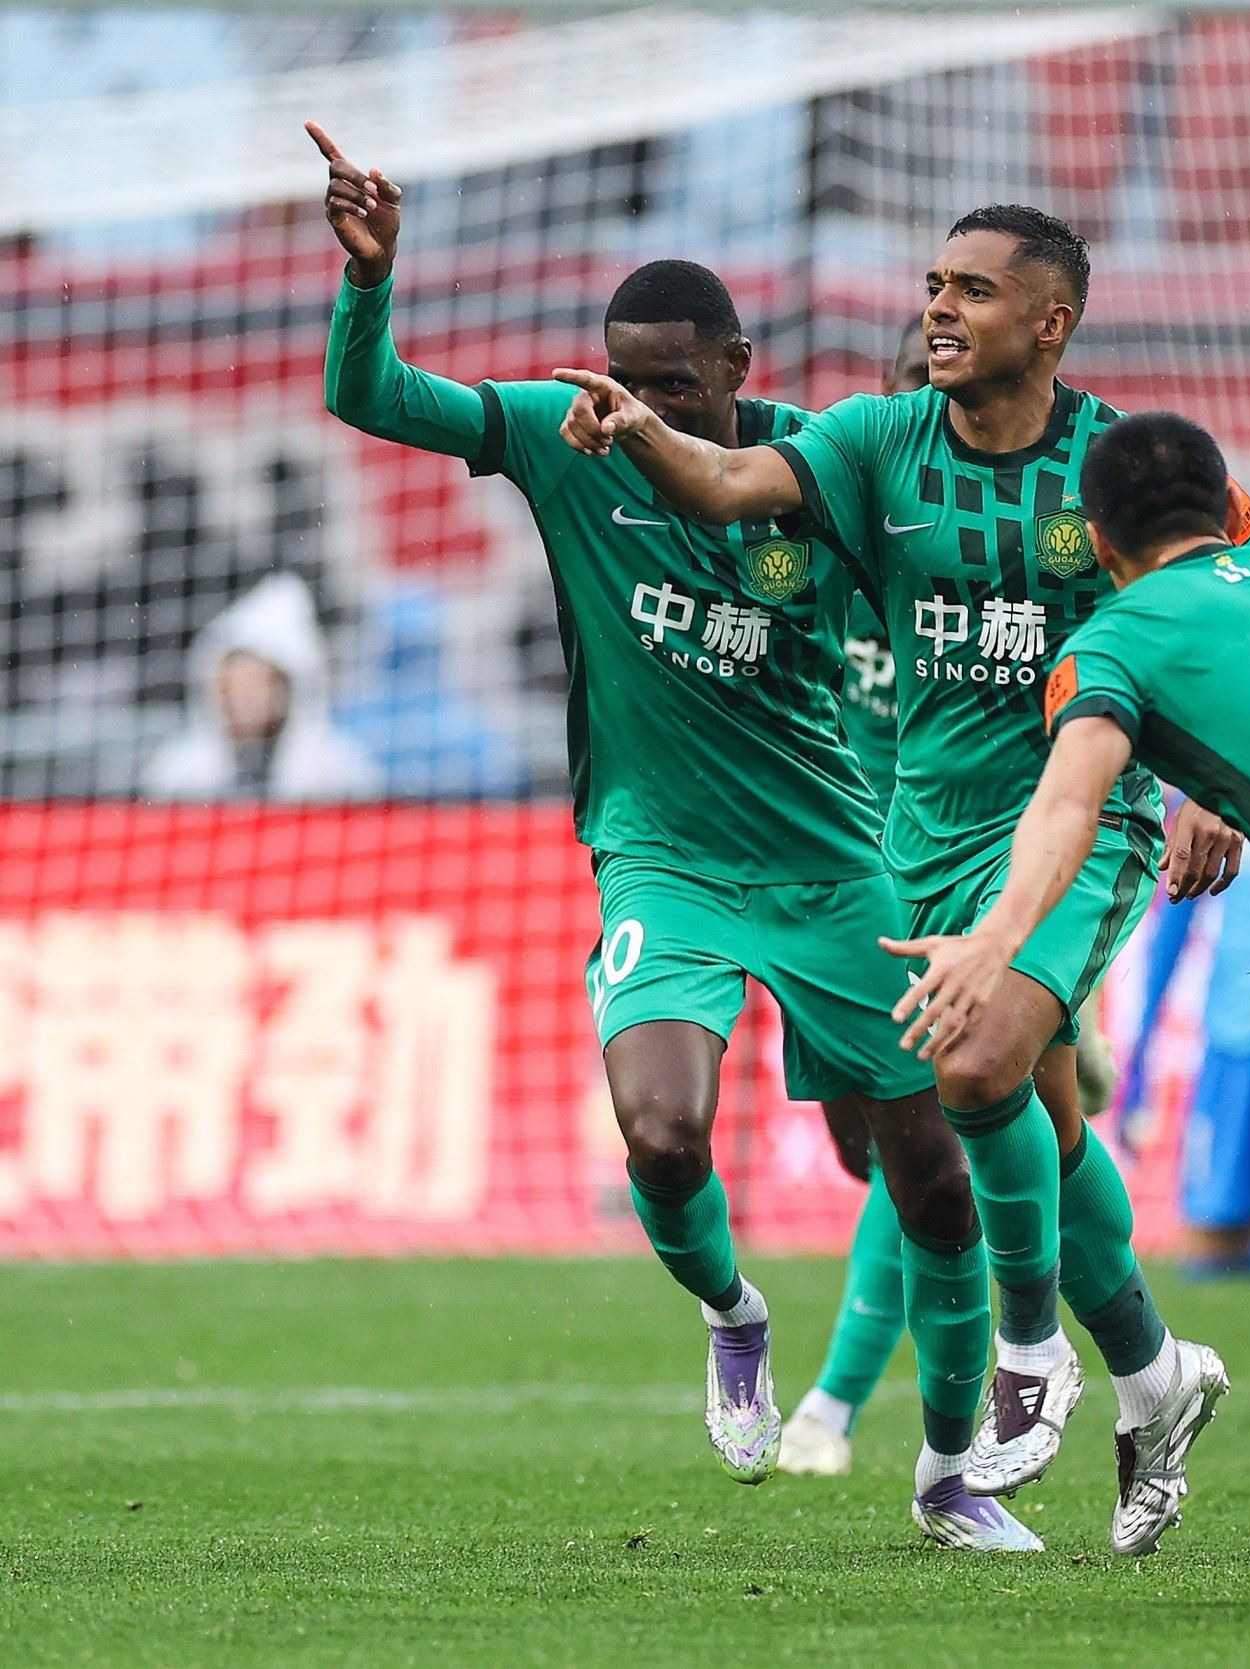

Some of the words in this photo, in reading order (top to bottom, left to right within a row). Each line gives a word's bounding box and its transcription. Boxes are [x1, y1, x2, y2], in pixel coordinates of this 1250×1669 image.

[630, 582, 772, 663] 中赫
[640, 634, 760, 678] SNOBO
[914, 594, 1047, 663] 中赫
[915, 658, 1037, 686] SINOBO
[0, 908, 496, 1220] 带劲
